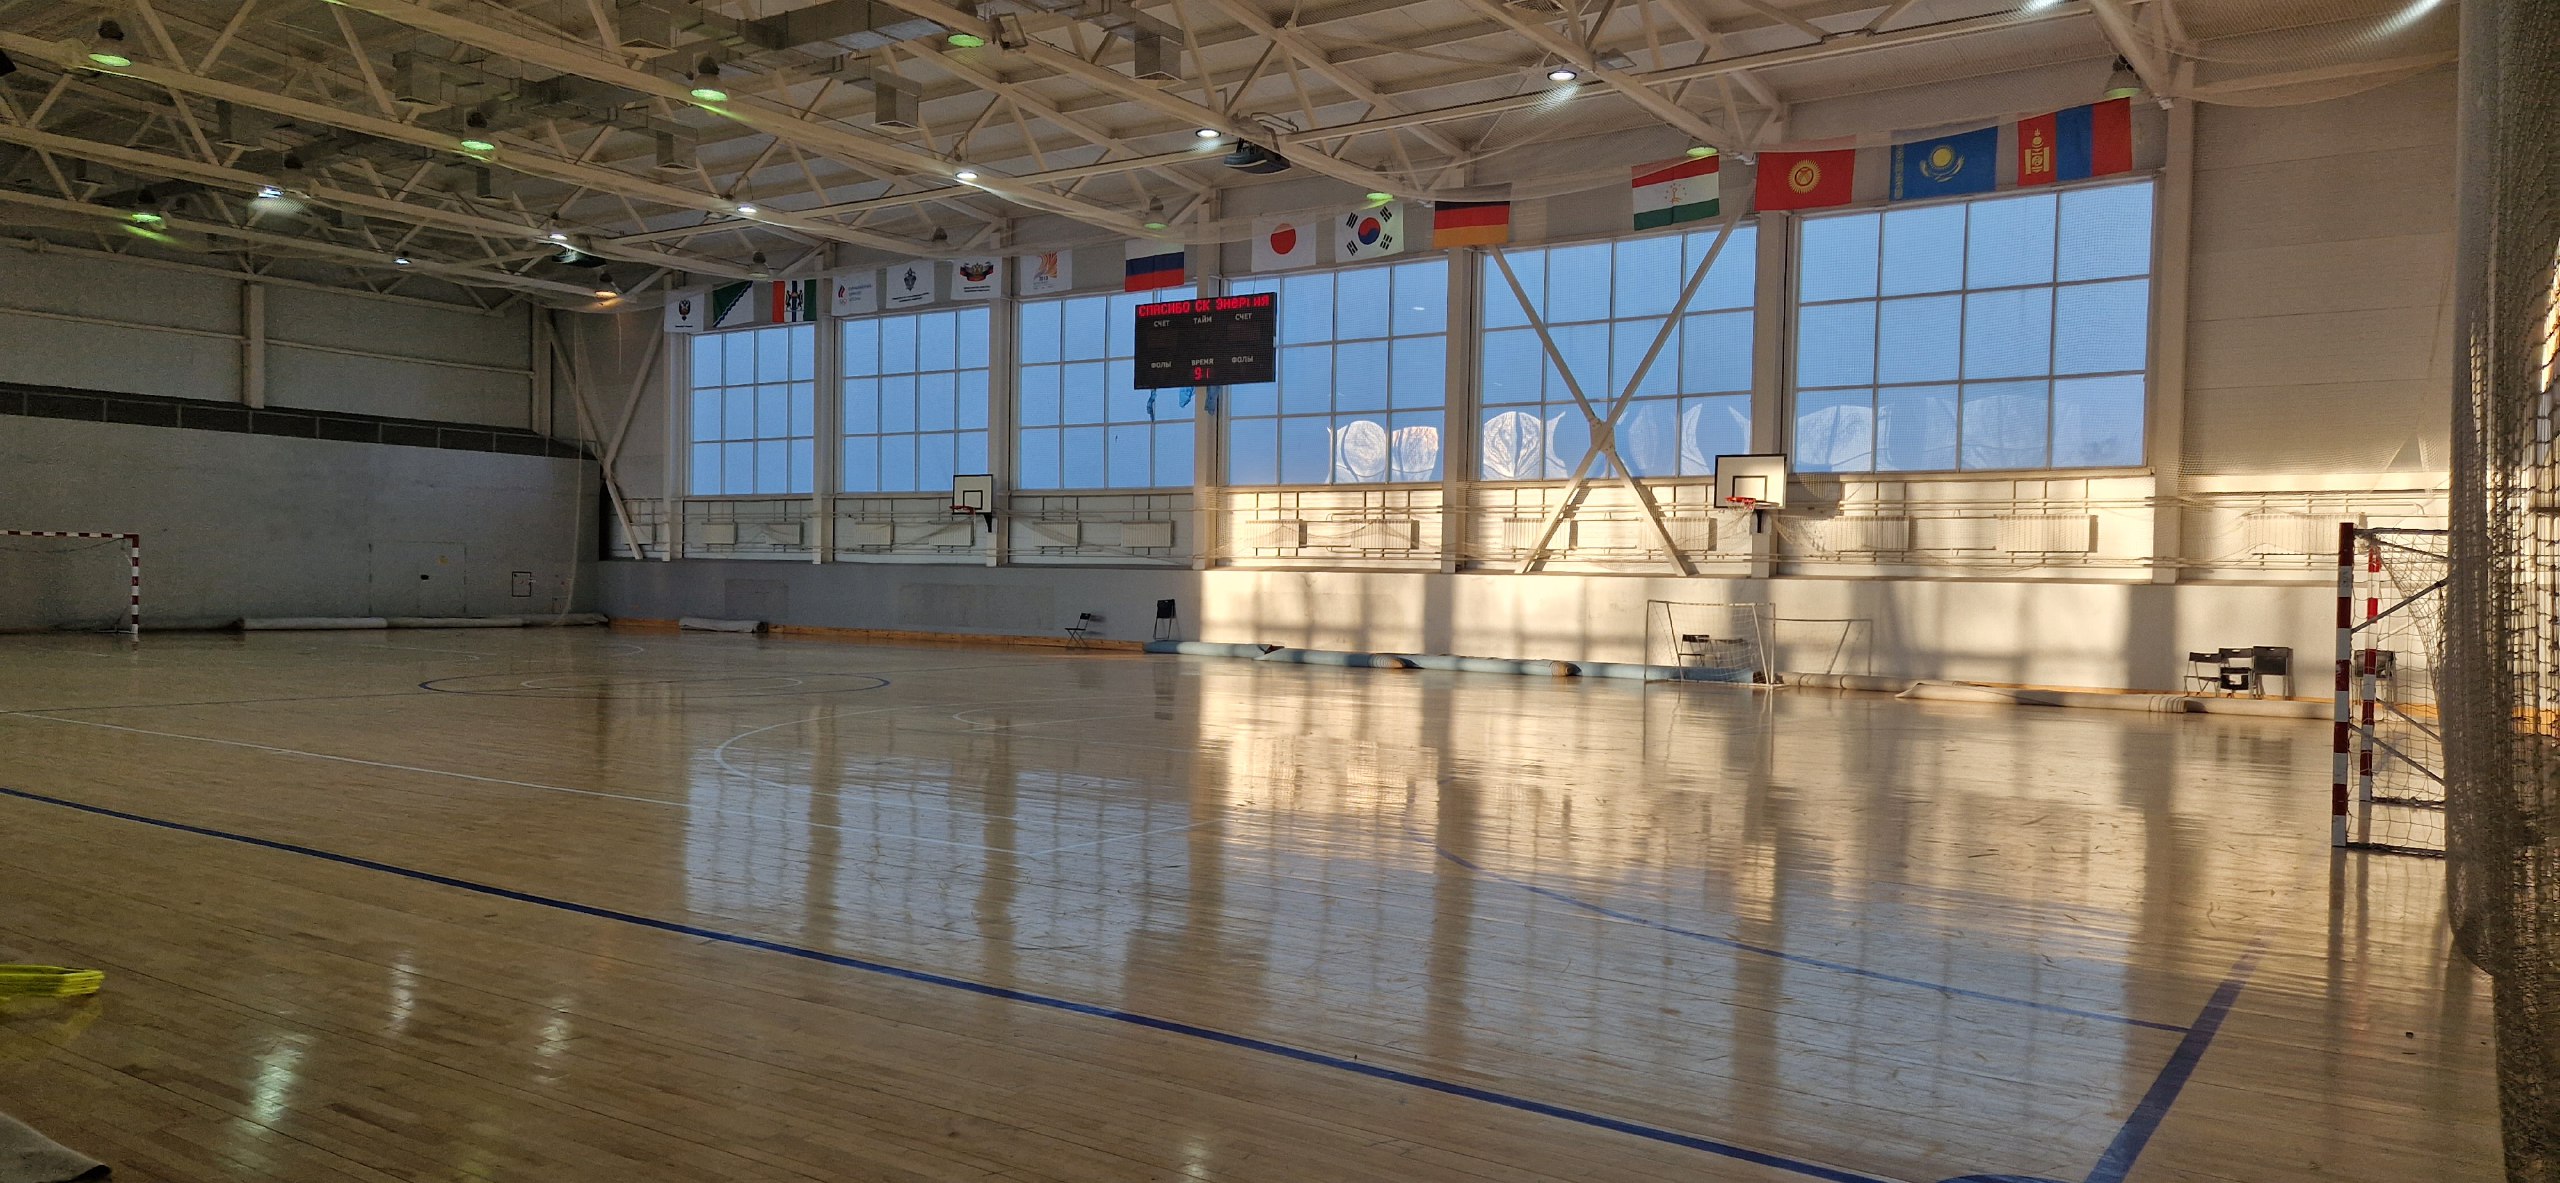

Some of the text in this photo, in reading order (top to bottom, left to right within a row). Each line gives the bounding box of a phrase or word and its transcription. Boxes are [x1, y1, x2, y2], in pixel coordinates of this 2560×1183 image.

[1195, 299, 1210, 313] СК
[1193, 315, 1213, 325] ТАЙМ
[1234, 312, 1253, 321] СЧЕТ
[1154, 320, 1170, 328] СЧЕТ
[1191, 357, 1214, 366] ВРЕМЯ
[1231, 355, 1254, 364] ФОЛЫ
[1150, 360, 1172, 369] ФОЛЫ
